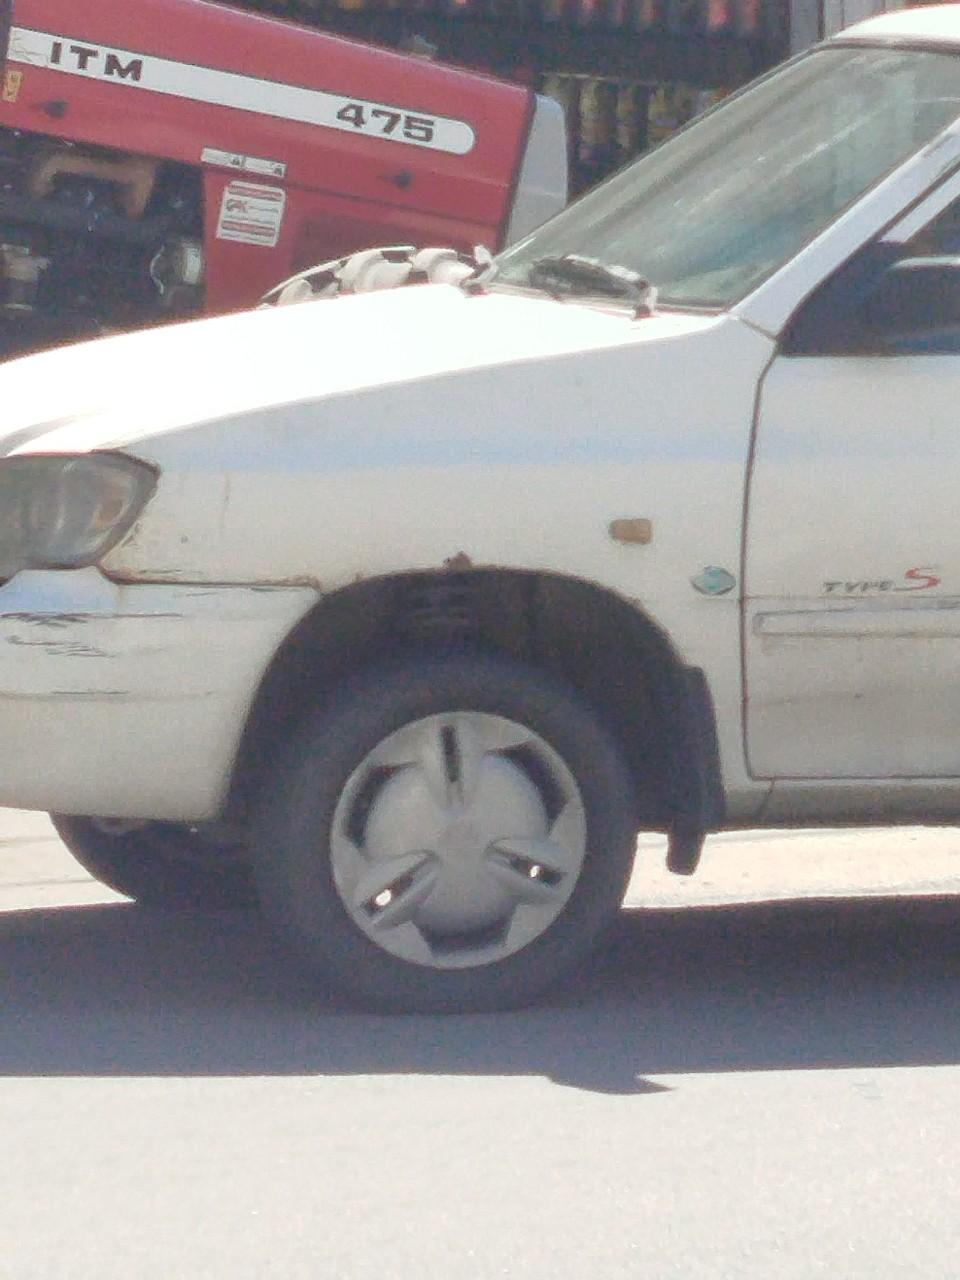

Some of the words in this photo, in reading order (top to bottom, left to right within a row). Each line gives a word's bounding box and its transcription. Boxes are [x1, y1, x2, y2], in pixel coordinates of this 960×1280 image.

[50, 41, 143, 82] ITM
[335, 102, 436, 144] 475
[822, 580, 894, 593] TYPE
